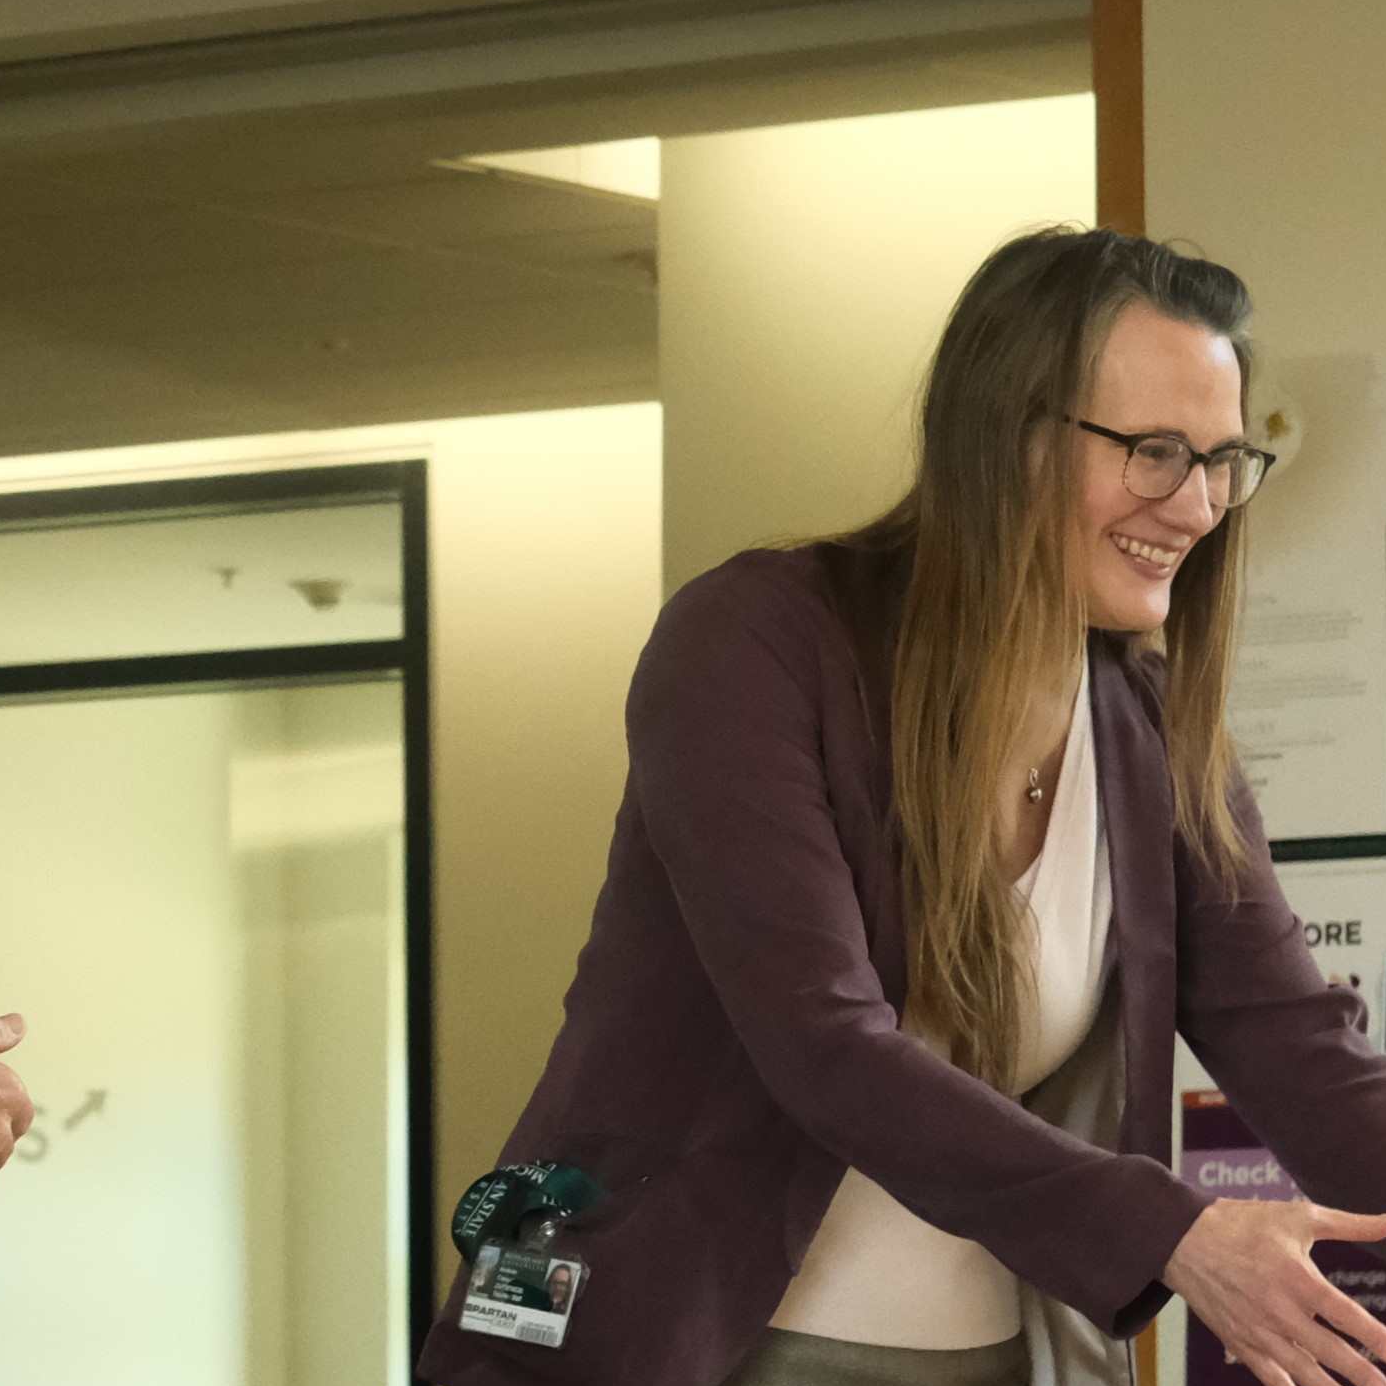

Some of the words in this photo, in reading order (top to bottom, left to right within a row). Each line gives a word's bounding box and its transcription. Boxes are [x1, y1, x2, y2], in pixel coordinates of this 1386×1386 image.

[1305, 920, 1362, 947] ORE
[1198, 1160, 1282, 1187] Check
[464, 1200, 496, 1238] STATE
[465, 1302, 518, 1322] SPARTAN
